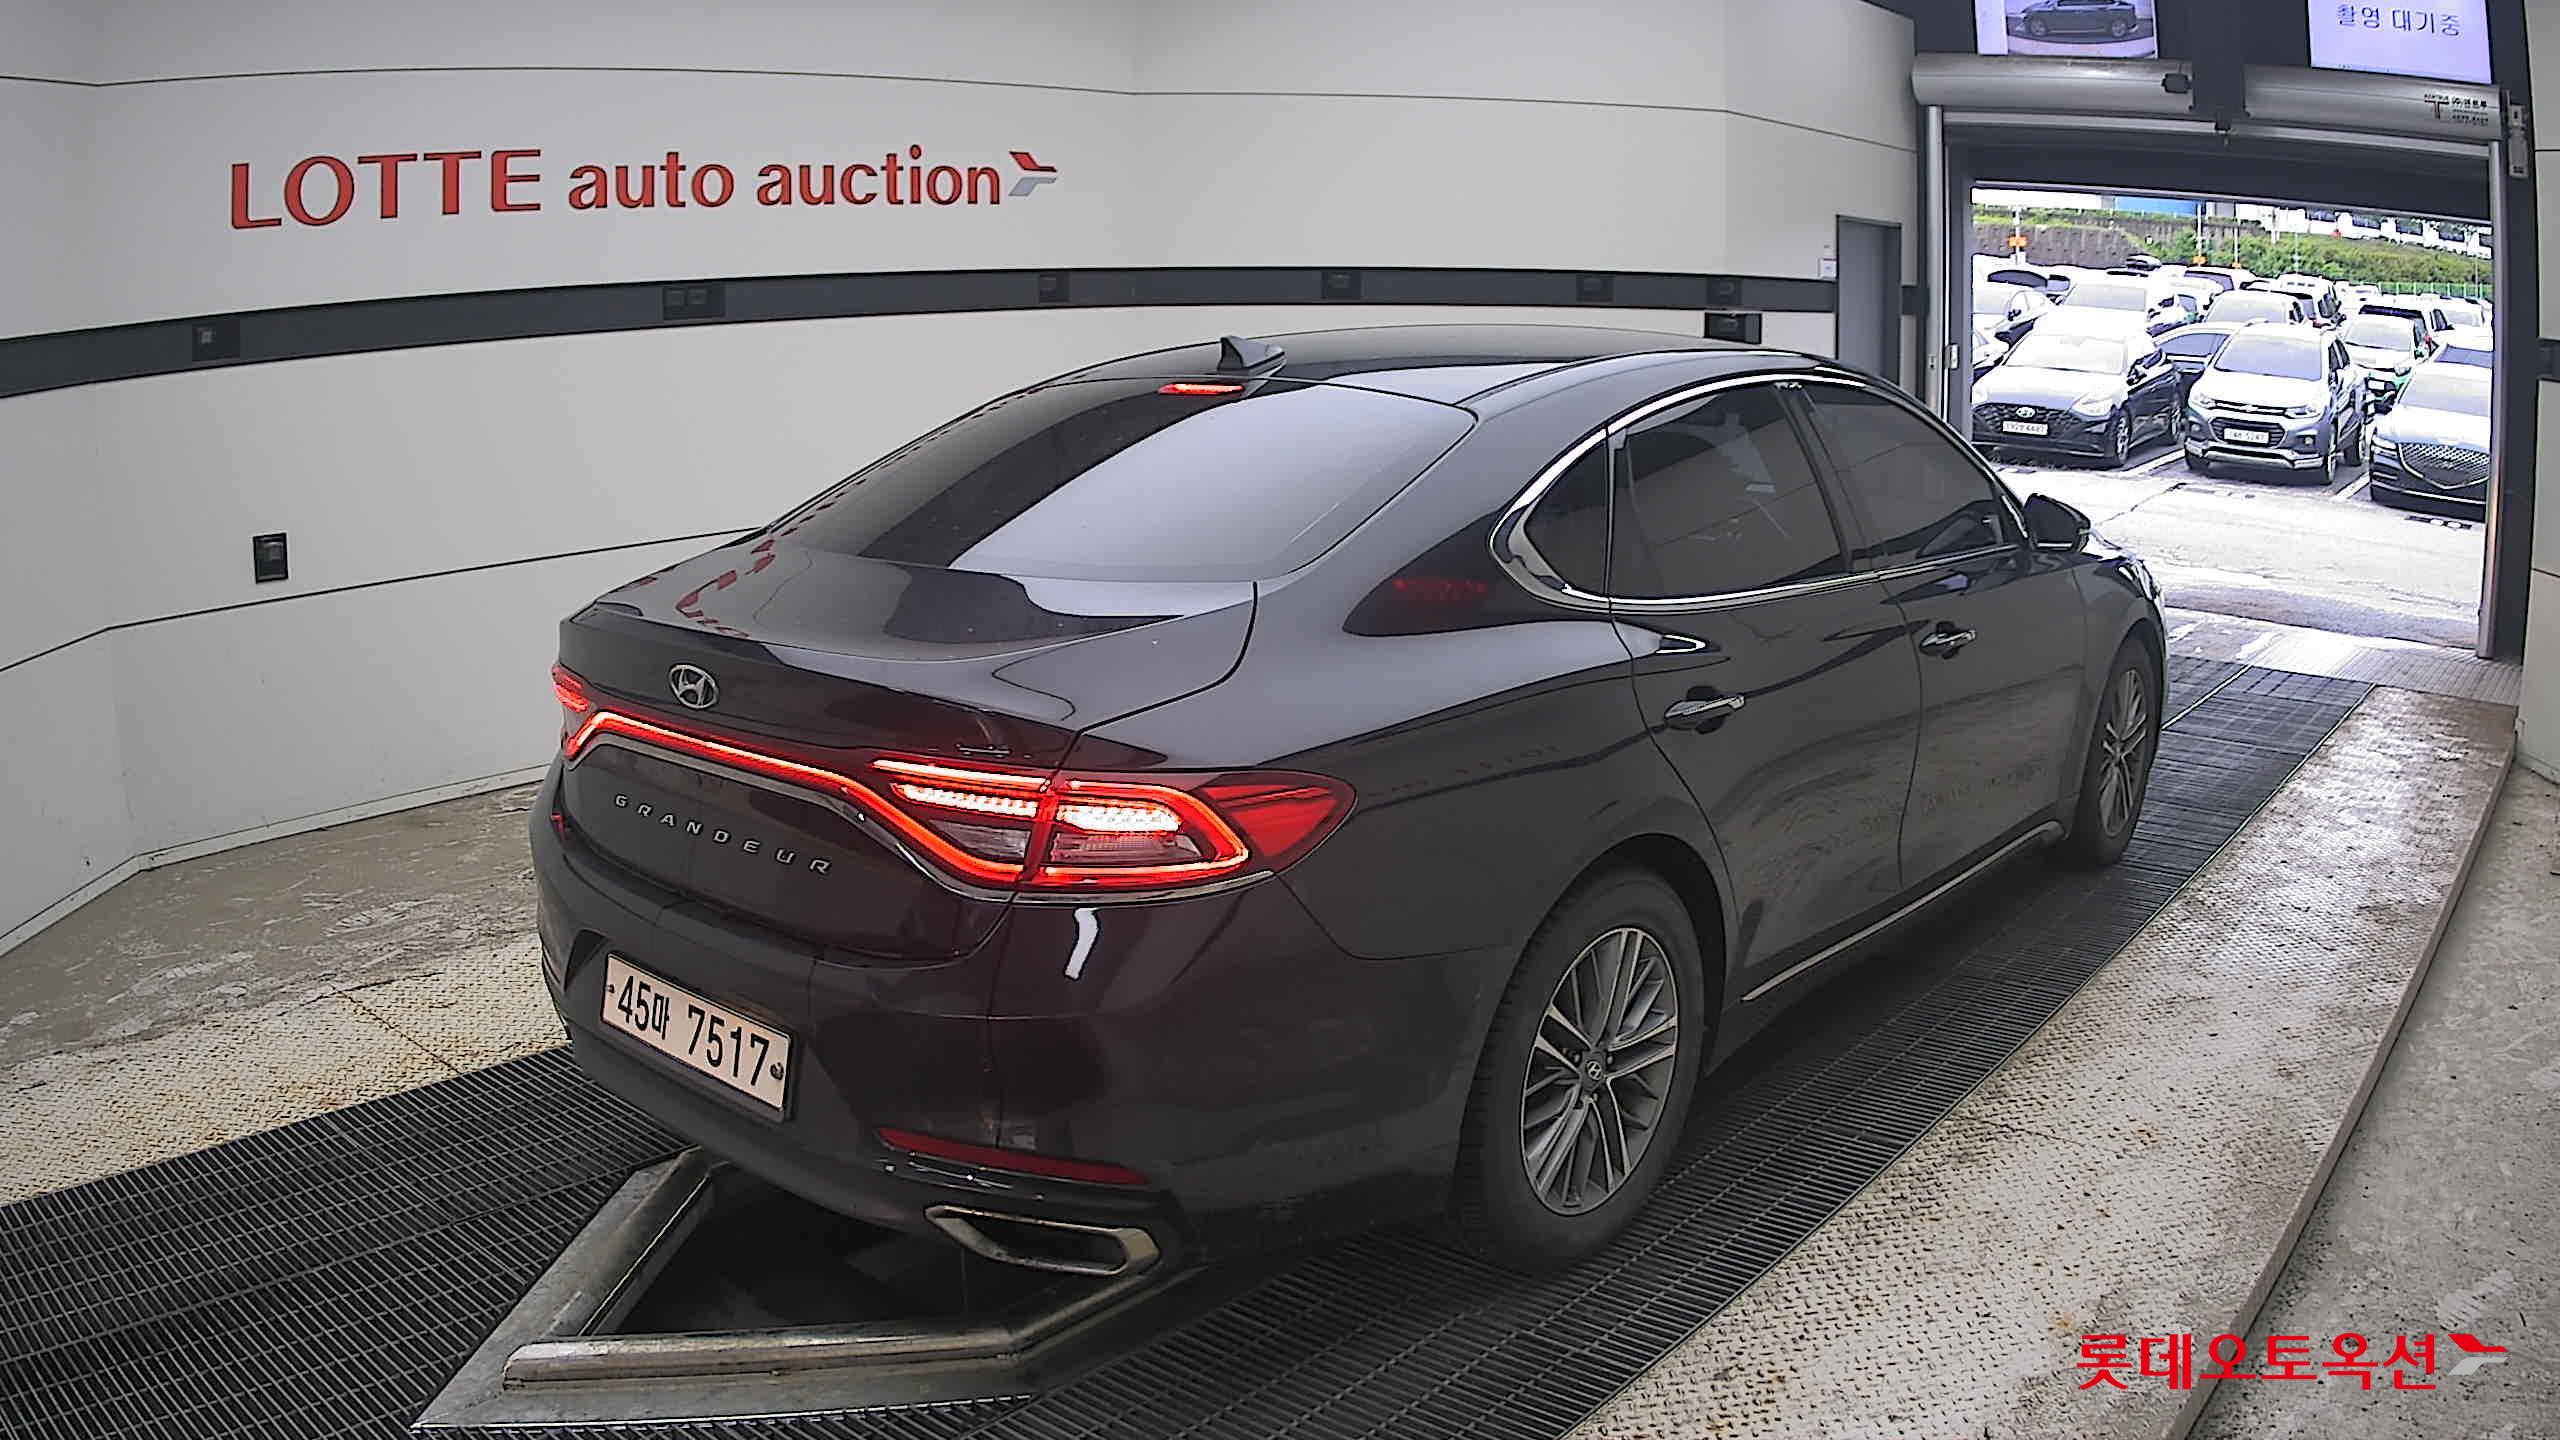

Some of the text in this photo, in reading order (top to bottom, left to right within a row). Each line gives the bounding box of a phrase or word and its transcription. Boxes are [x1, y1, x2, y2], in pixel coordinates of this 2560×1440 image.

[2391, 8, 2461, 37] 대기중
[230, 144, 1002, 230] LOTTE auto auction
[614, 794, 832, 873] GRANDEUR
[617, 975, 771, 1087] 45마 7517
